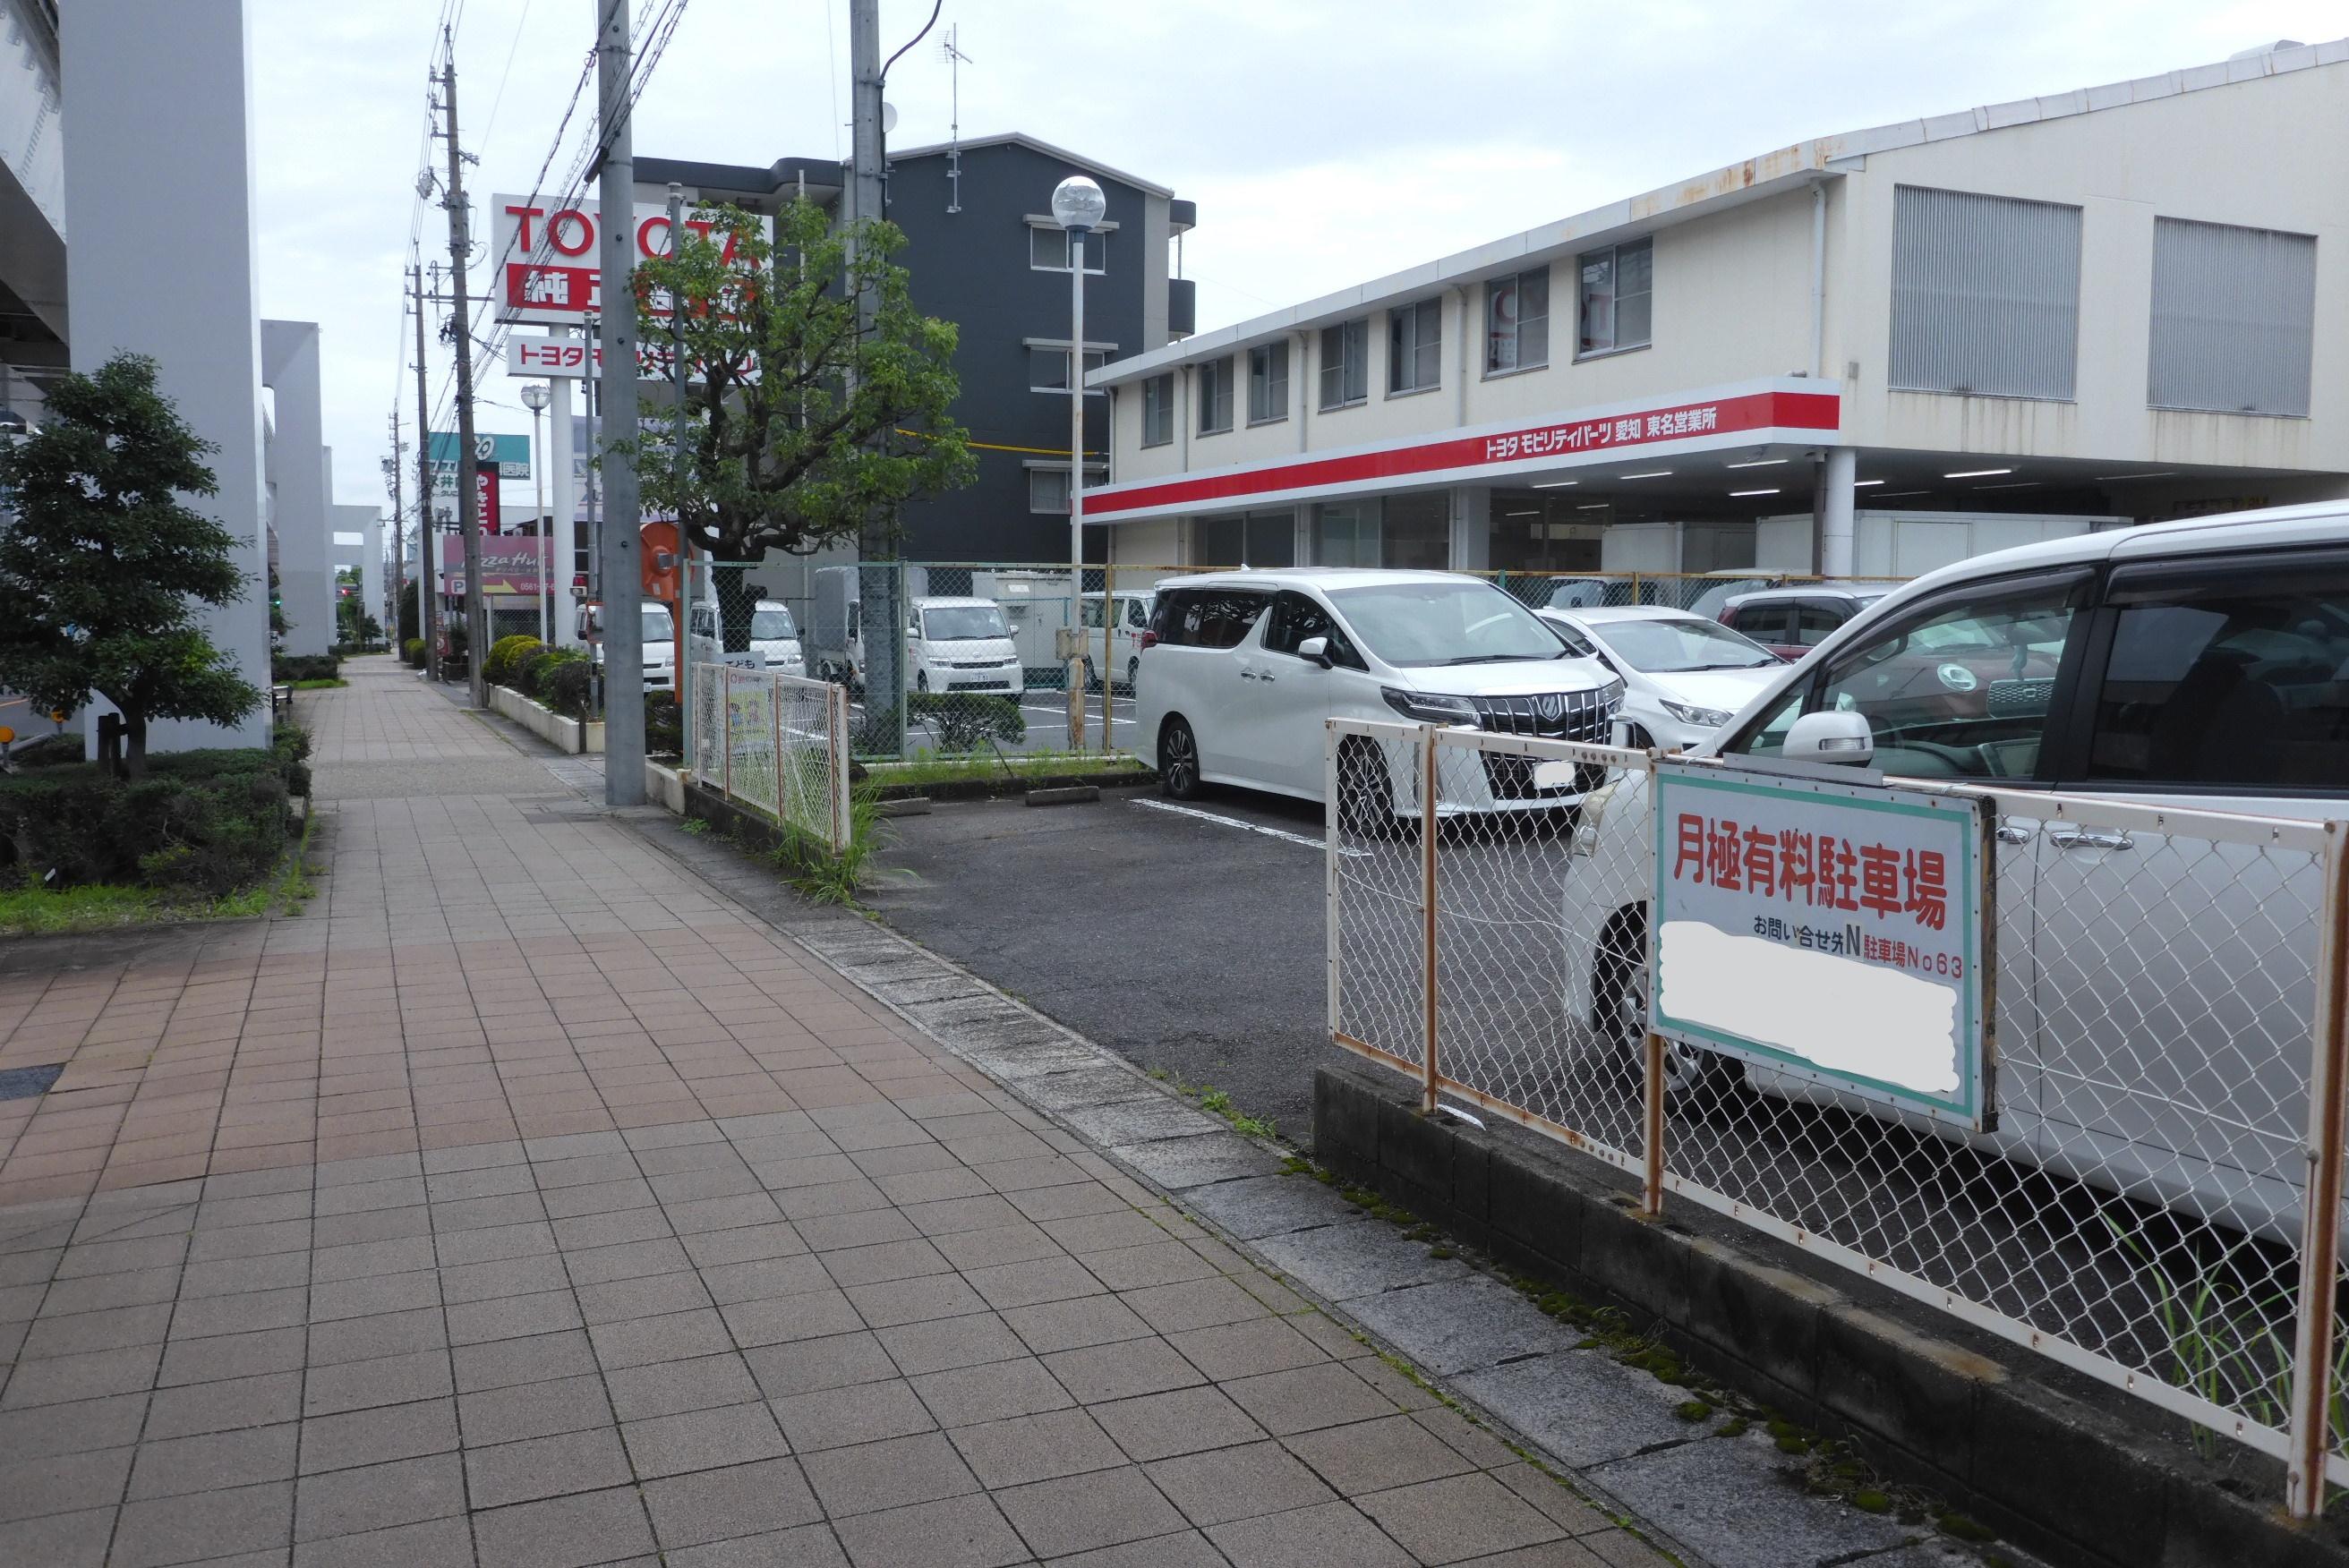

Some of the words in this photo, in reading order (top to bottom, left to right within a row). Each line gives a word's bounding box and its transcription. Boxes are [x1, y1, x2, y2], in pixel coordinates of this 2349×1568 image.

[1615, 418, 1641, 442] 愛知
[1646, 406, 1717, 437] 東名営業所
[1673, 813, 1947, 931] 月極有料駐車場
